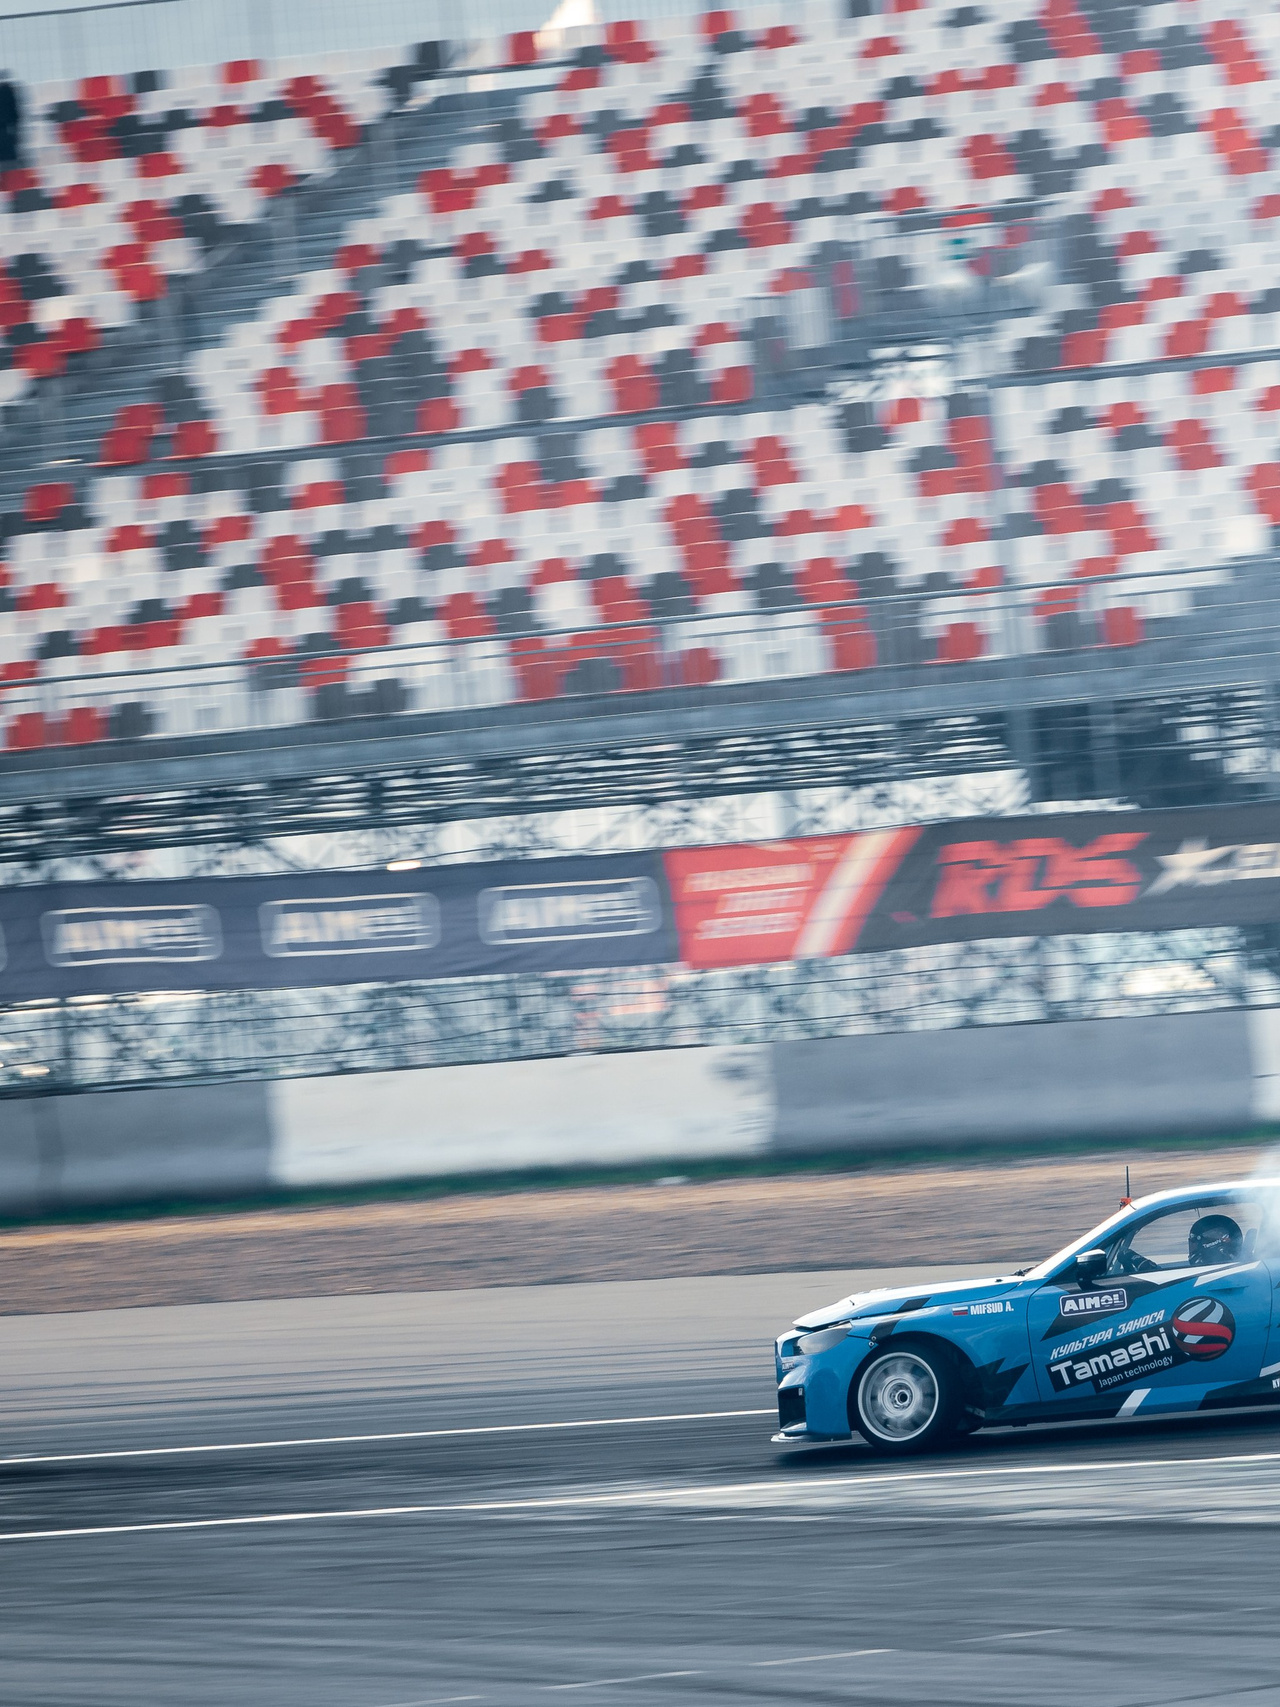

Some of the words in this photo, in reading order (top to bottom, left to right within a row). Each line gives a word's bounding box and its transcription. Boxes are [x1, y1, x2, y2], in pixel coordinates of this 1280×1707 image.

[930, 832, 1149, 918] RDS
[970, 1302, 1003, 1316] MIFSUD
[1005, 1301, 1015, 1312] A.
[1063, 1293, 1124, 1313] AIMOL
[1050, 1328, 1114, 1361] КУЛЬТУРА
[1116, 1309, 1166, 1338] ЗАНОСА
[1050, 1327, 1171, 1386] Tamashi
[1098, 1371, 1124, 1388] Japan
[1124, 1355, 1174, 1378] technology
